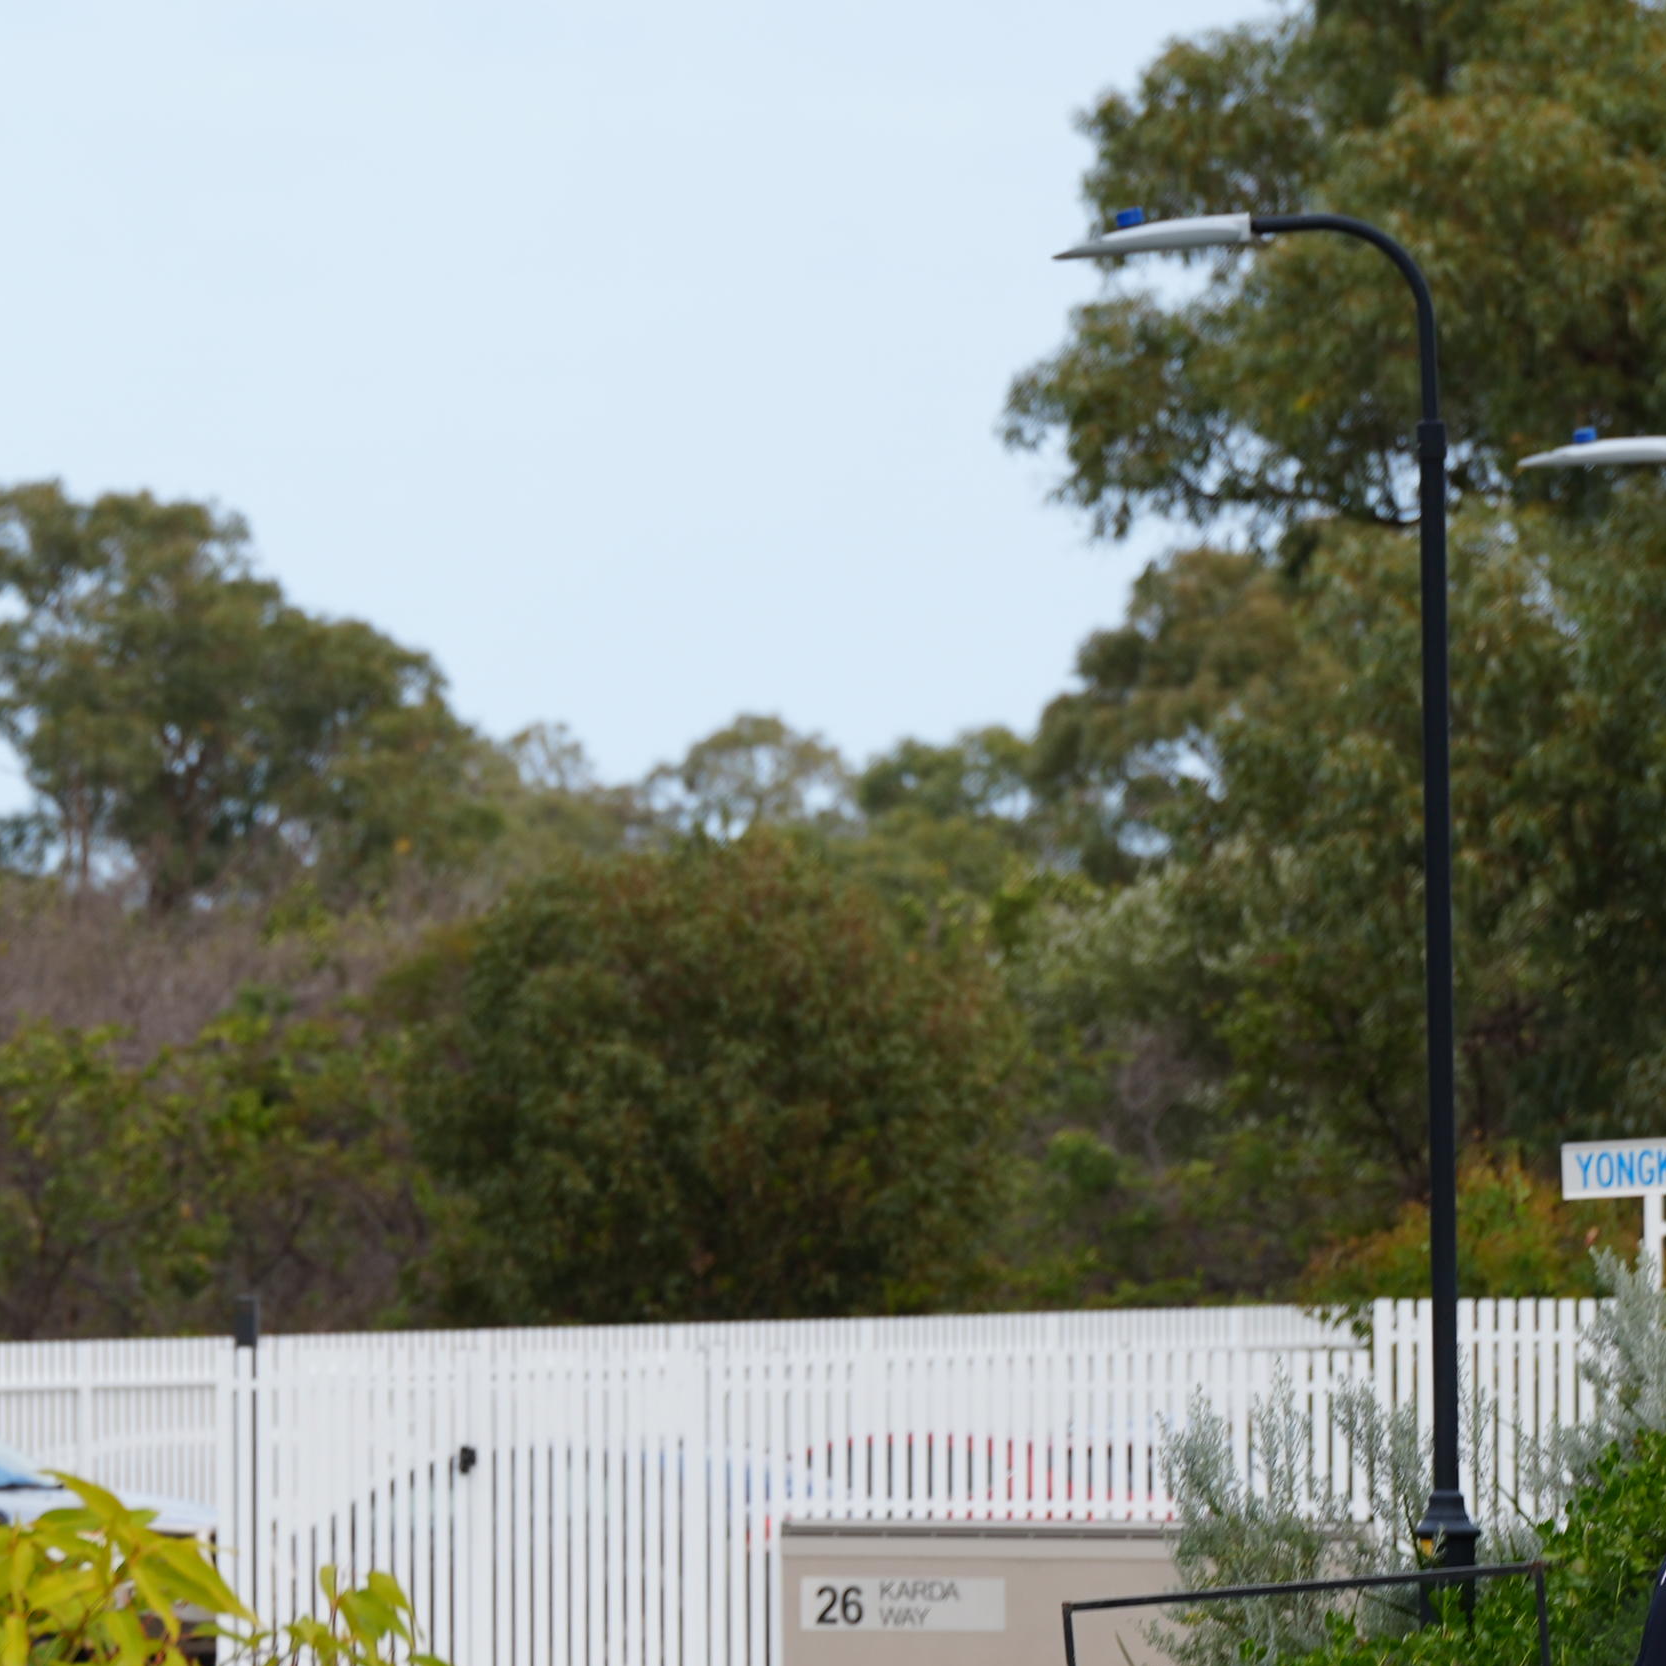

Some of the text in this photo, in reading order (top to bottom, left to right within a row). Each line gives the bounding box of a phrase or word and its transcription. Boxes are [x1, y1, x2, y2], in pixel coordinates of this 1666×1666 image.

[879, 1580, 960, 1602] KARDA
[816, 1585, 864, 1626] 26
[878, 1606, 932, 1627] WAY
